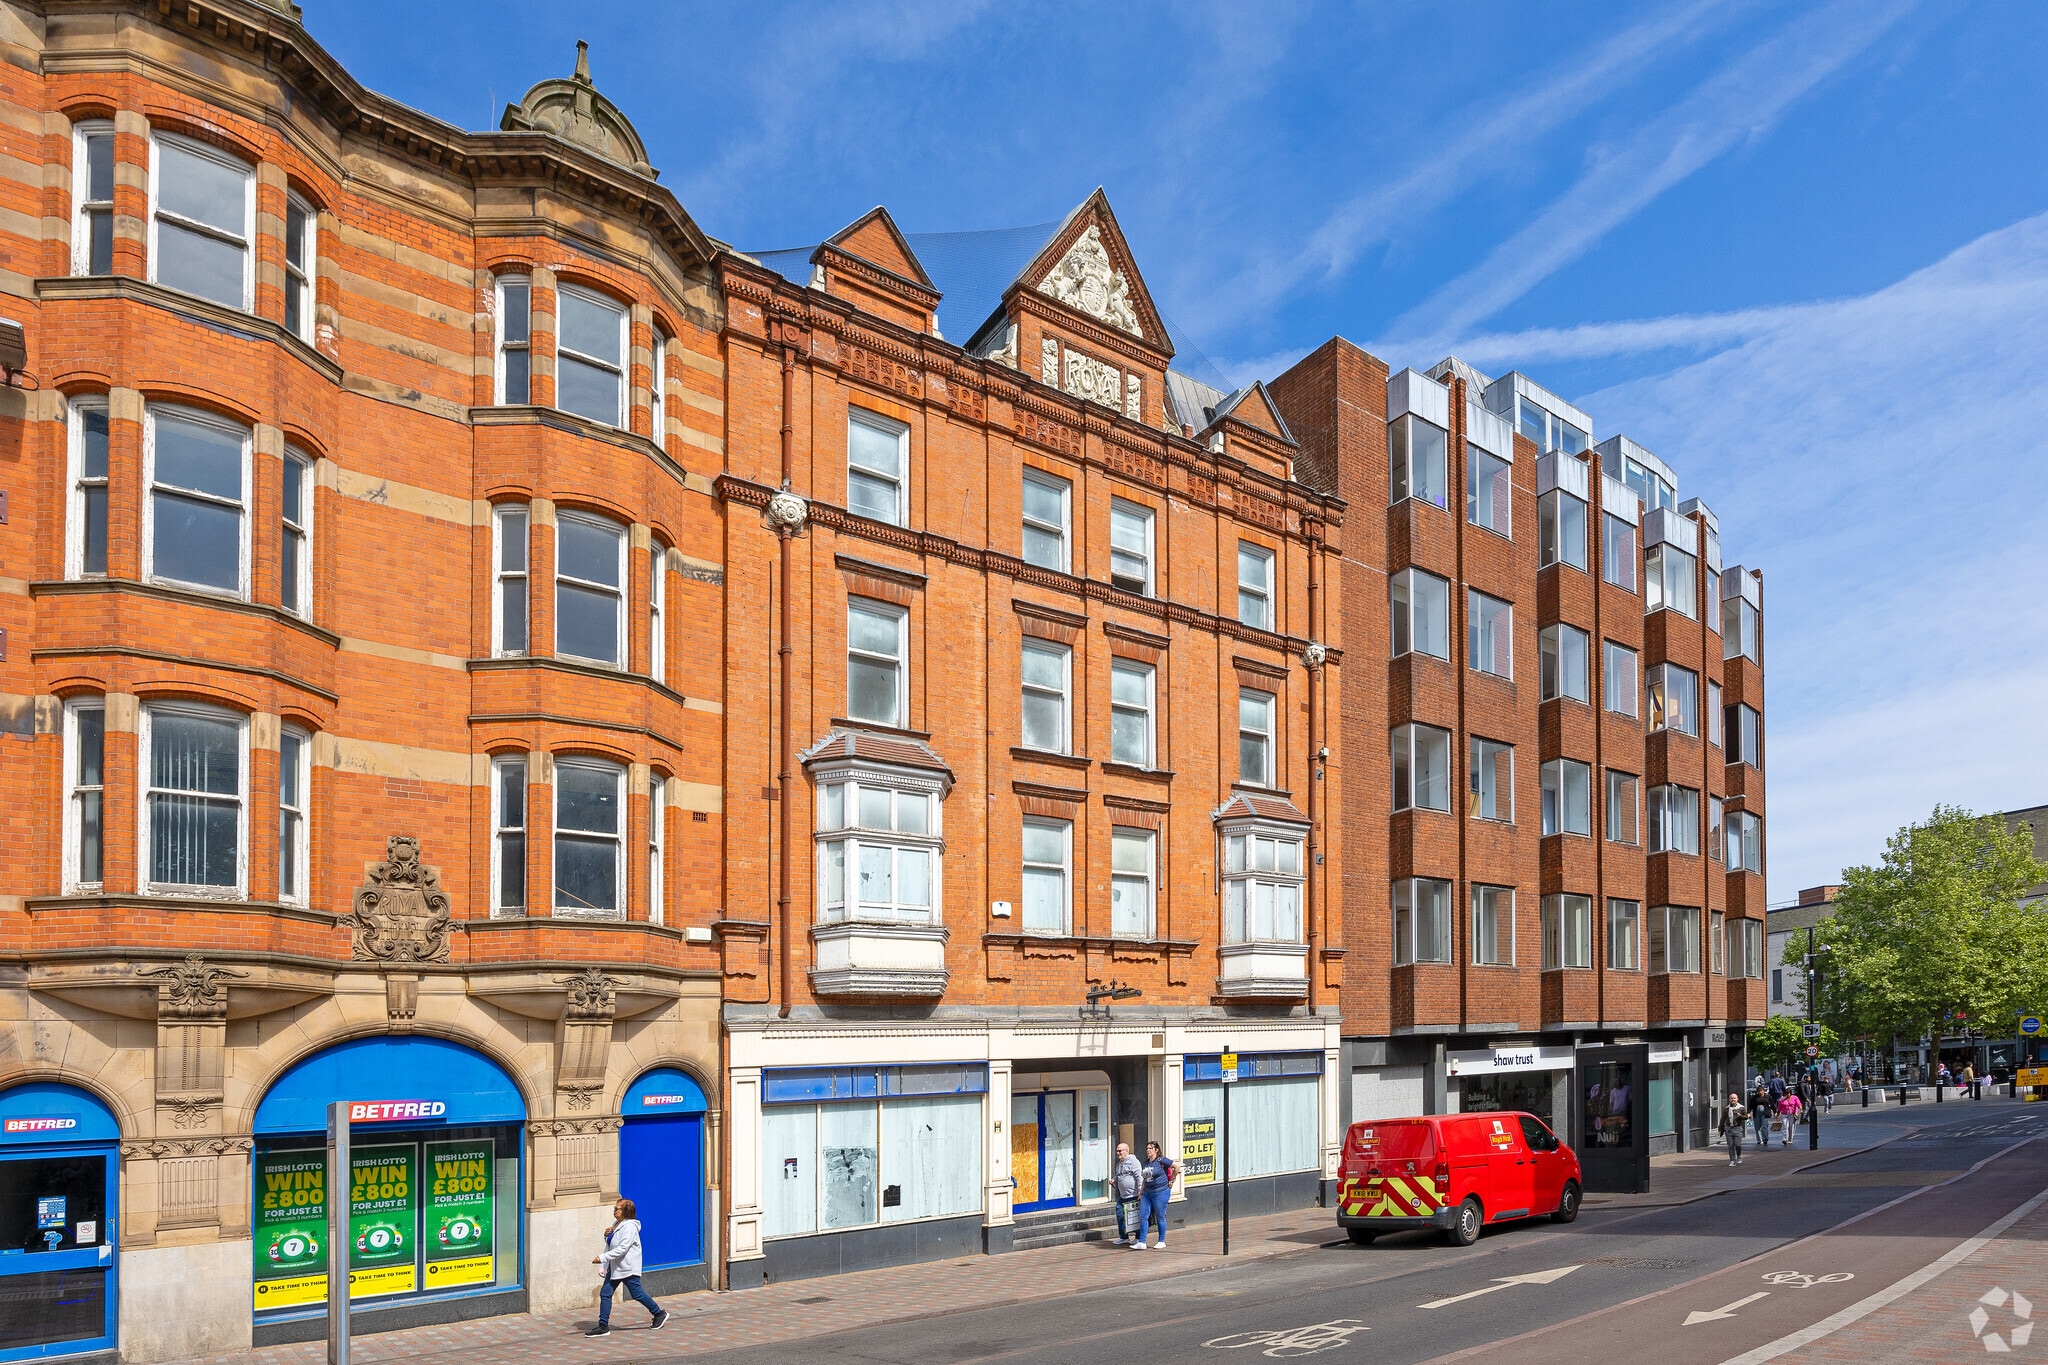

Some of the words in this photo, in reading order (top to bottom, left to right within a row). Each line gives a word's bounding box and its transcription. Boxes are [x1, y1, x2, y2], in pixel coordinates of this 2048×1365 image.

[1065, 359, 1120, 402] ROYAL
[380, 894, 427, 919] ROYAL
[1494, 1054, 1514, 1066] shaw
[1515, 1054, 1534, 1065] trust
[644, 1096, 683, 1104] BETFRED
[352, 1102, 446, 1119] BETFRED
[8, 1119, 76, 1130] BETFRED
[1183, 1145, 1195, 1154] TO
[1198, 1143, 1213, 1152] LET
[353, 1165, 406, 1184] WIN
[435, 1160, 484, 1178] WIN
[1197, 1164, 1212, 1173] 3373
[265, 1171, 322, 1191] WIN
[433, 1177, 486, 1194] £800
[263, 1189, 324, 1208] £800
[352, 1183, 407, 1201] £800
[286, 1207, 311, 1216] JUST
[377, 1234, 383, 1242] 7
[290, 1243, 297, 1251] 7
